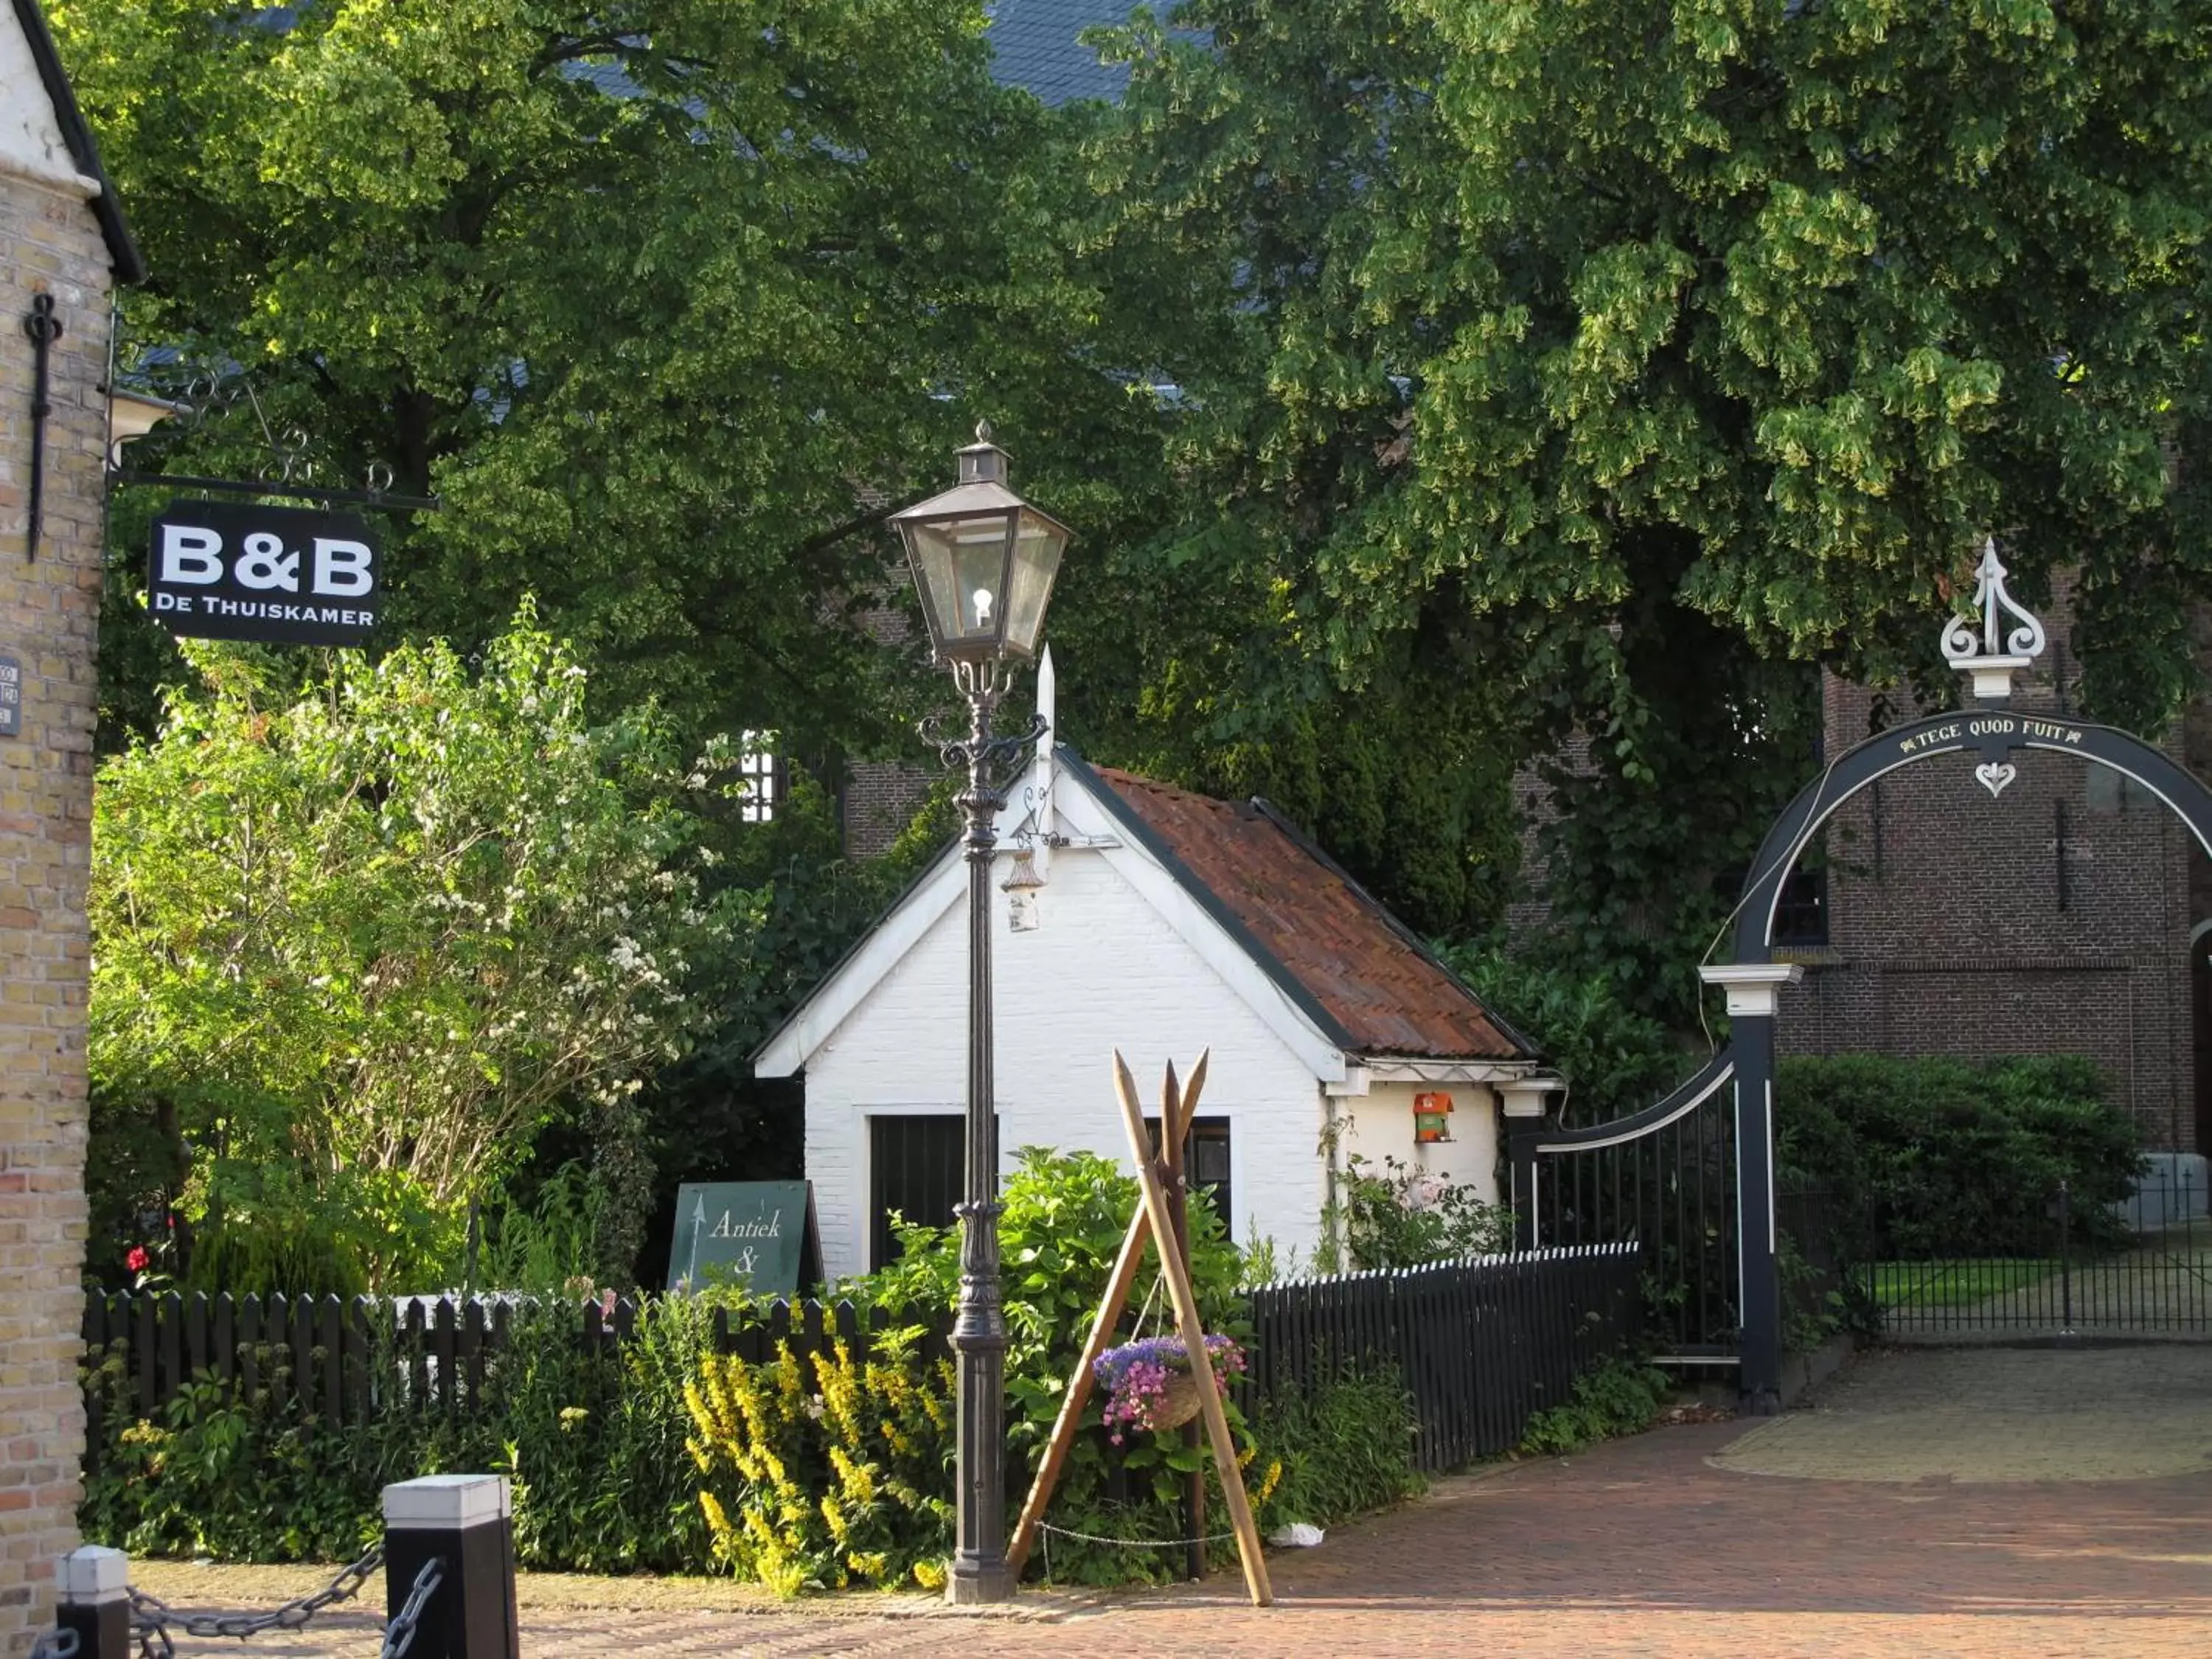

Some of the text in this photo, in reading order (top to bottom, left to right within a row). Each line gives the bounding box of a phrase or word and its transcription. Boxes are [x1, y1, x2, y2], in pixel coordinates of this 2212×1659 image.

[159, 524, 373, 597] B&B
[156, 592, 374, 626] DE THUISKAMER
[1916, 719, 2065, 747] TEGE QUOD FUIT
[709, 1209, 782, 1238] Antiek
[734, 1245, 760, 1274] &
